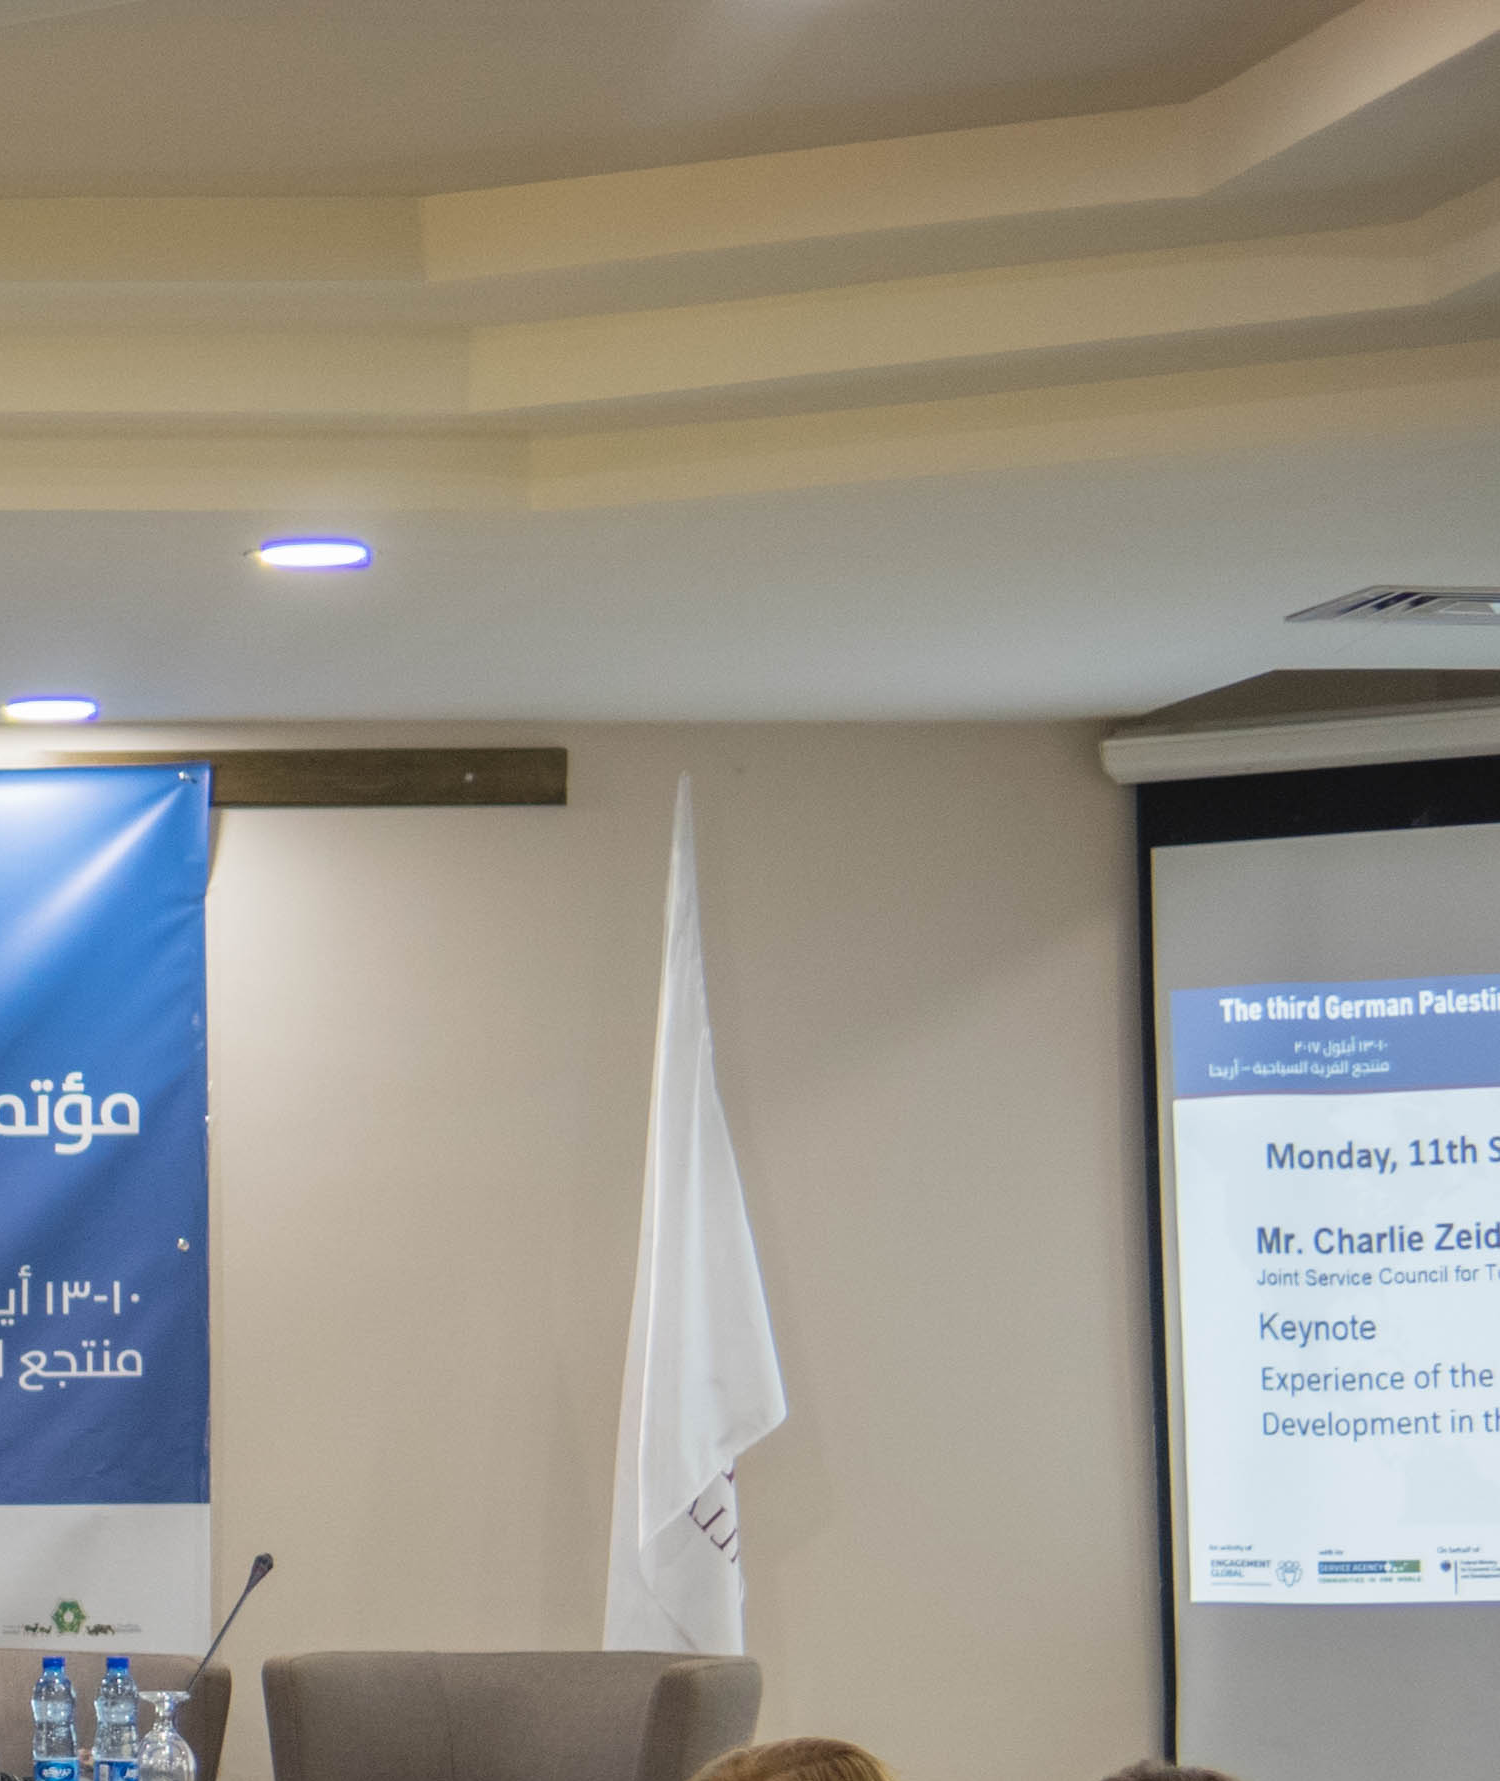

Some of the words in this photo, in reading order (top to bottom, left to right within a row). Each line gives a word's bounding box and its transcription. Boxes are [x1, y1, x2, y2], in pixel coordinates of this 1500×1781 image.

[1218, 998, 1263, 1023] The
[1266, 995, 1320, 1020] third
[1324, 993, 1414, 1020] German
[1418, 986, 1500, 1015] Palesti
[1266, 1141, 1397, 1174] Monday,
[1409, 1136, 1478, 1167] 11th
[1257, 1226, 1304, 1255] Mr.
[1313, 1224, 1424, 1255] Charlie
[1257, 1268, 1299, 1287] Joint
[1305, 1268, 1372, 1287] Service
[1379, 1265, 1448, 1284] Council
[1453, 1264, 1479, 1282] for
[1259, 1313, 1377, 1348] Keynote
[18, 1339, 143, 1391] منتجع
[1261, 1366, 1405, 1397] Experience
[1414, 1363, 1441, 1390] of
[1450, 1363, 1494, 1389] the
[1262, 1410, 1441, 1442] Development
[1450, 1408, 1474, 1434] in
